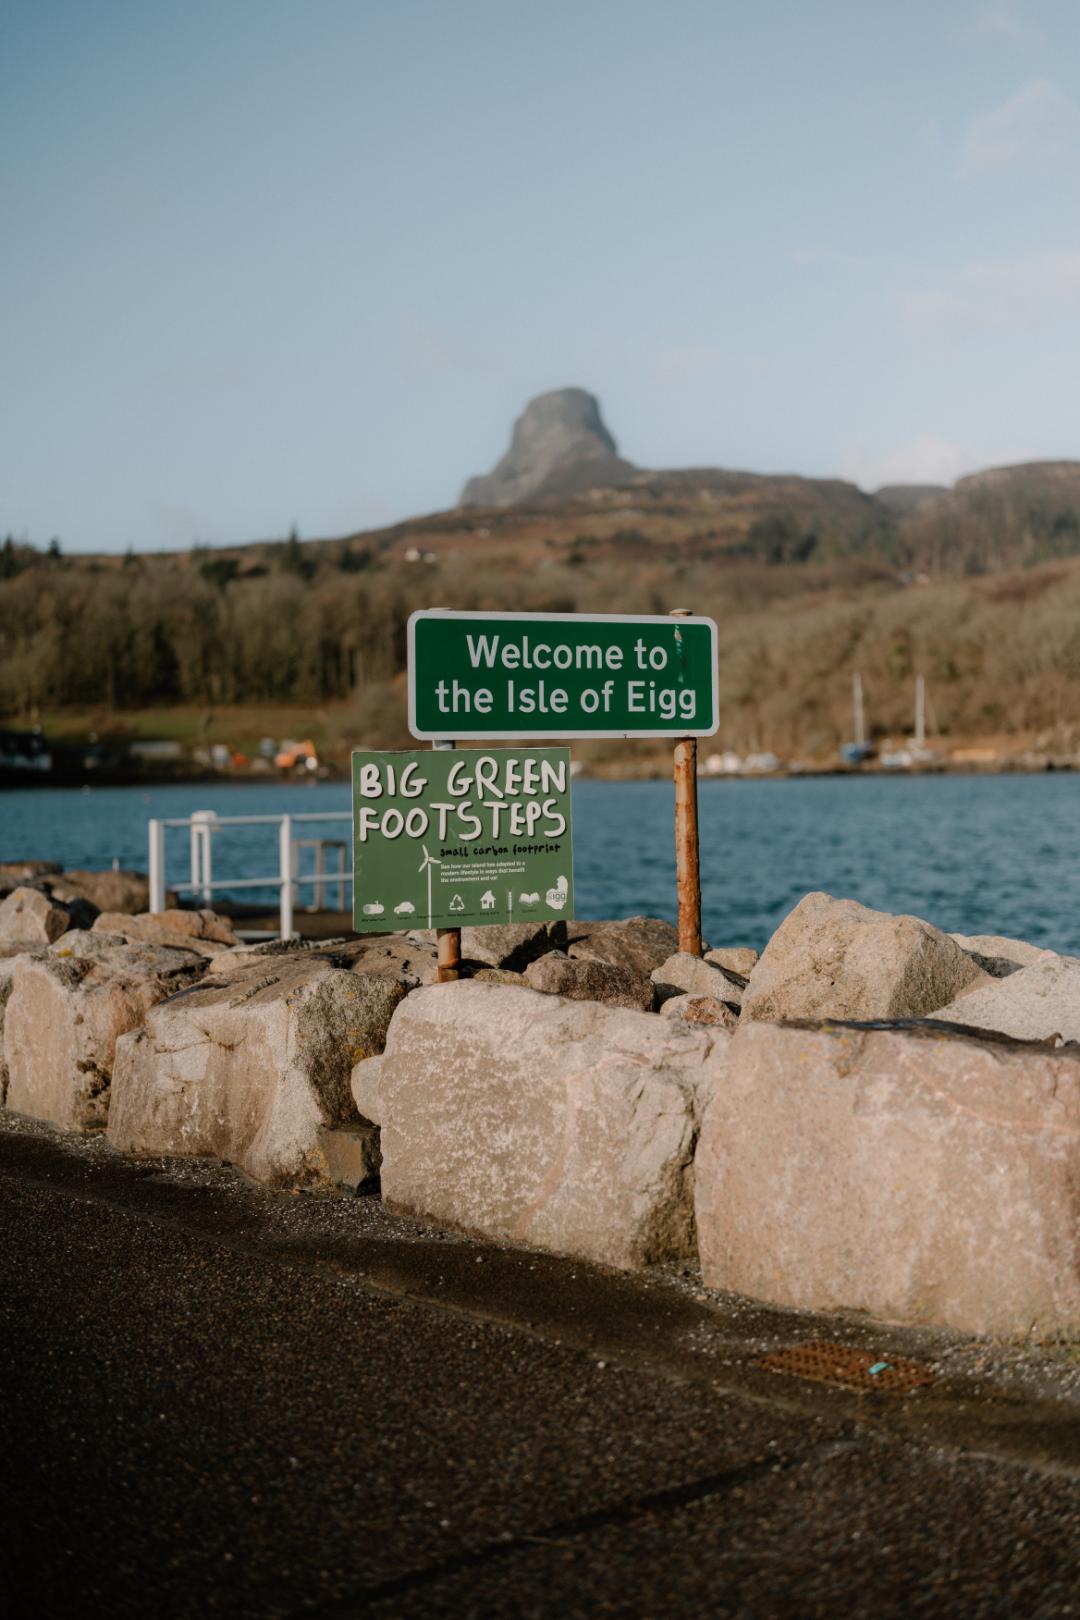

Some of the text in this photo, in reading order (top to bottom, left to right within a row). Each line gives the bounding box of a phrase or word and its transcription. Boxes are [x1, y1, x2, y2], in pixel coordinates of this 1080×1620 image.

[466, 634, 668, 670] Welcome to
[435, 679, 696, 719] the Isle of Eigg
[360, 756, 566, 799] BIG GREEN
[359, 798, 566, 842] FOOTSTEPS
[440, 843, 561, 857] small carbon footprint
